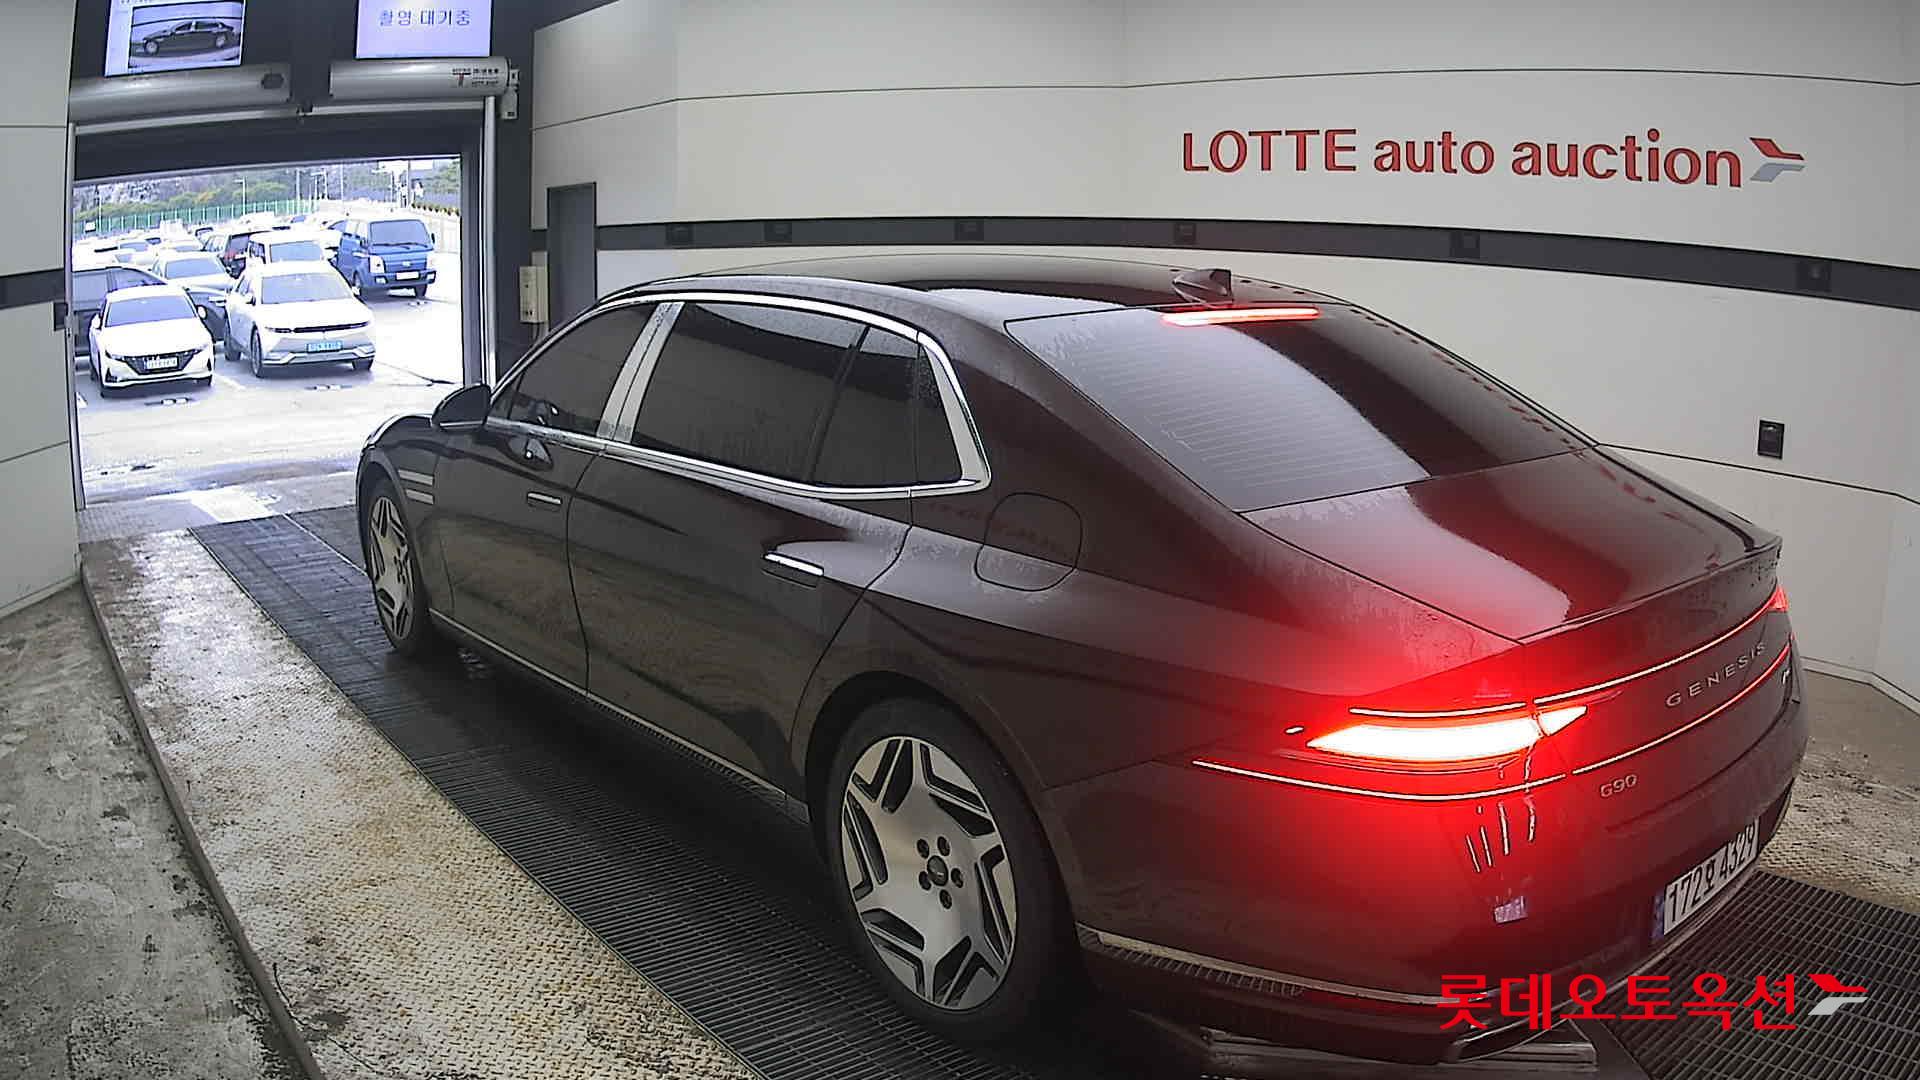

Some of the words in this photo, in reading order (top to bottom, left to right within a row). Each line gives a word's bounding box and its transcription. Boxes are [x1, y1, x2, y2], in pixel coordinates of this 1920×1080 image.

[1183, 128, 1357, 173] LOTTE
[1374, 131, 1495, 174] auto
[1511, 128, 1742, 188] auction
[1666, 642, 1766, 706] GENESIS
[1601, 774, 1637, 797] G90
